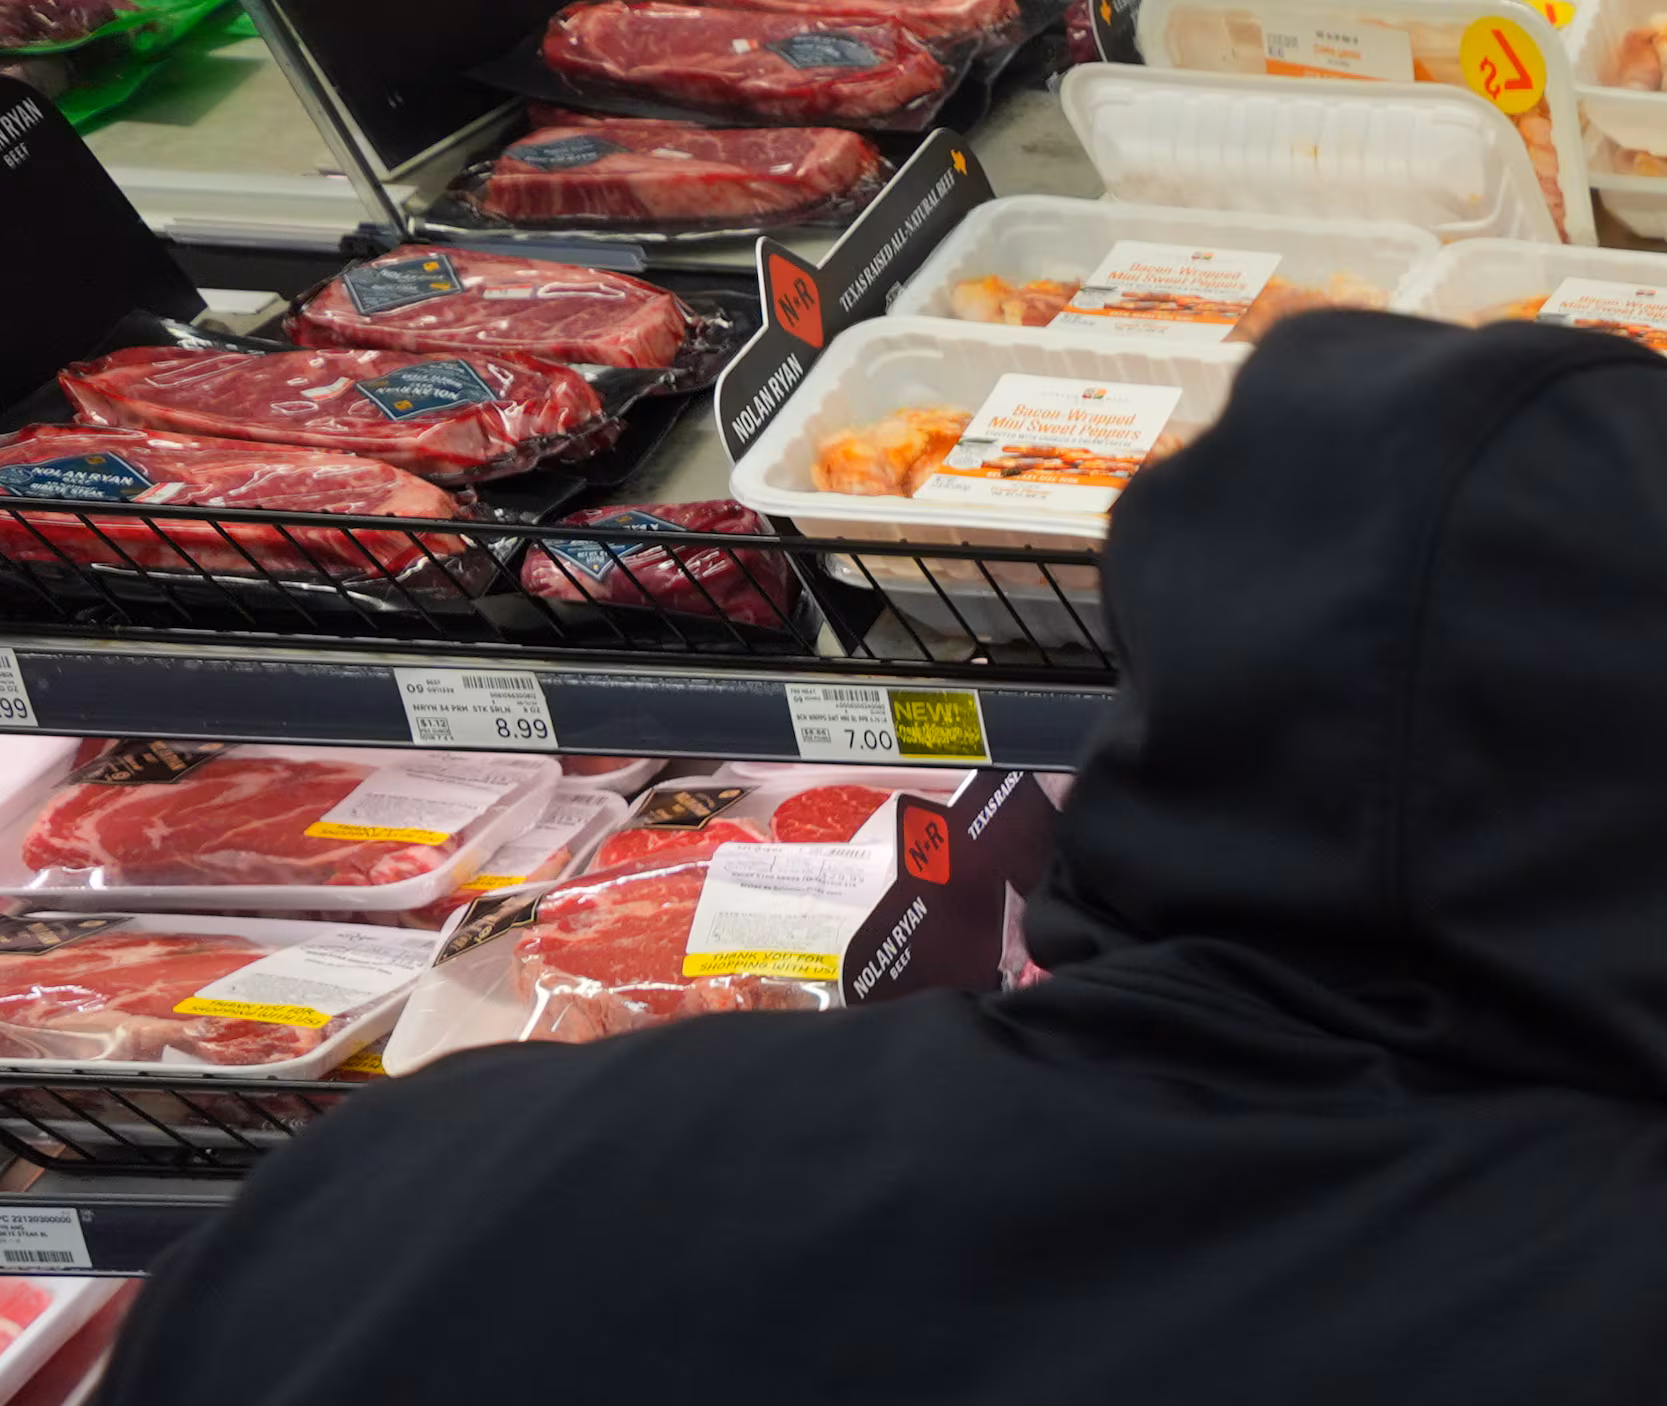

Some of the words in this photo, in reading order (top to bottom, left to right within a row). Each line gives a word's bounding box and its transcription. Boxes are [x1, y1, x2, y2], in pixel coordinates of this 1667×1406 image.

[839, 273, 868, 312] TEXAS
[863, 241, 895, 285] RAISED
[732, 384, 780, 443] NOLAN
[769, 353, 803, 403] RYAN
[495, 717, 549, 740] 8.99
[843, 729, 893, 750] 7.00
[967, 808, 997, 841] TEXAS
[853, 937, 896, 1000] NOLAN
[891, 897, 928, 950] RYAN
[890, 947, 913, 981] BEEF
